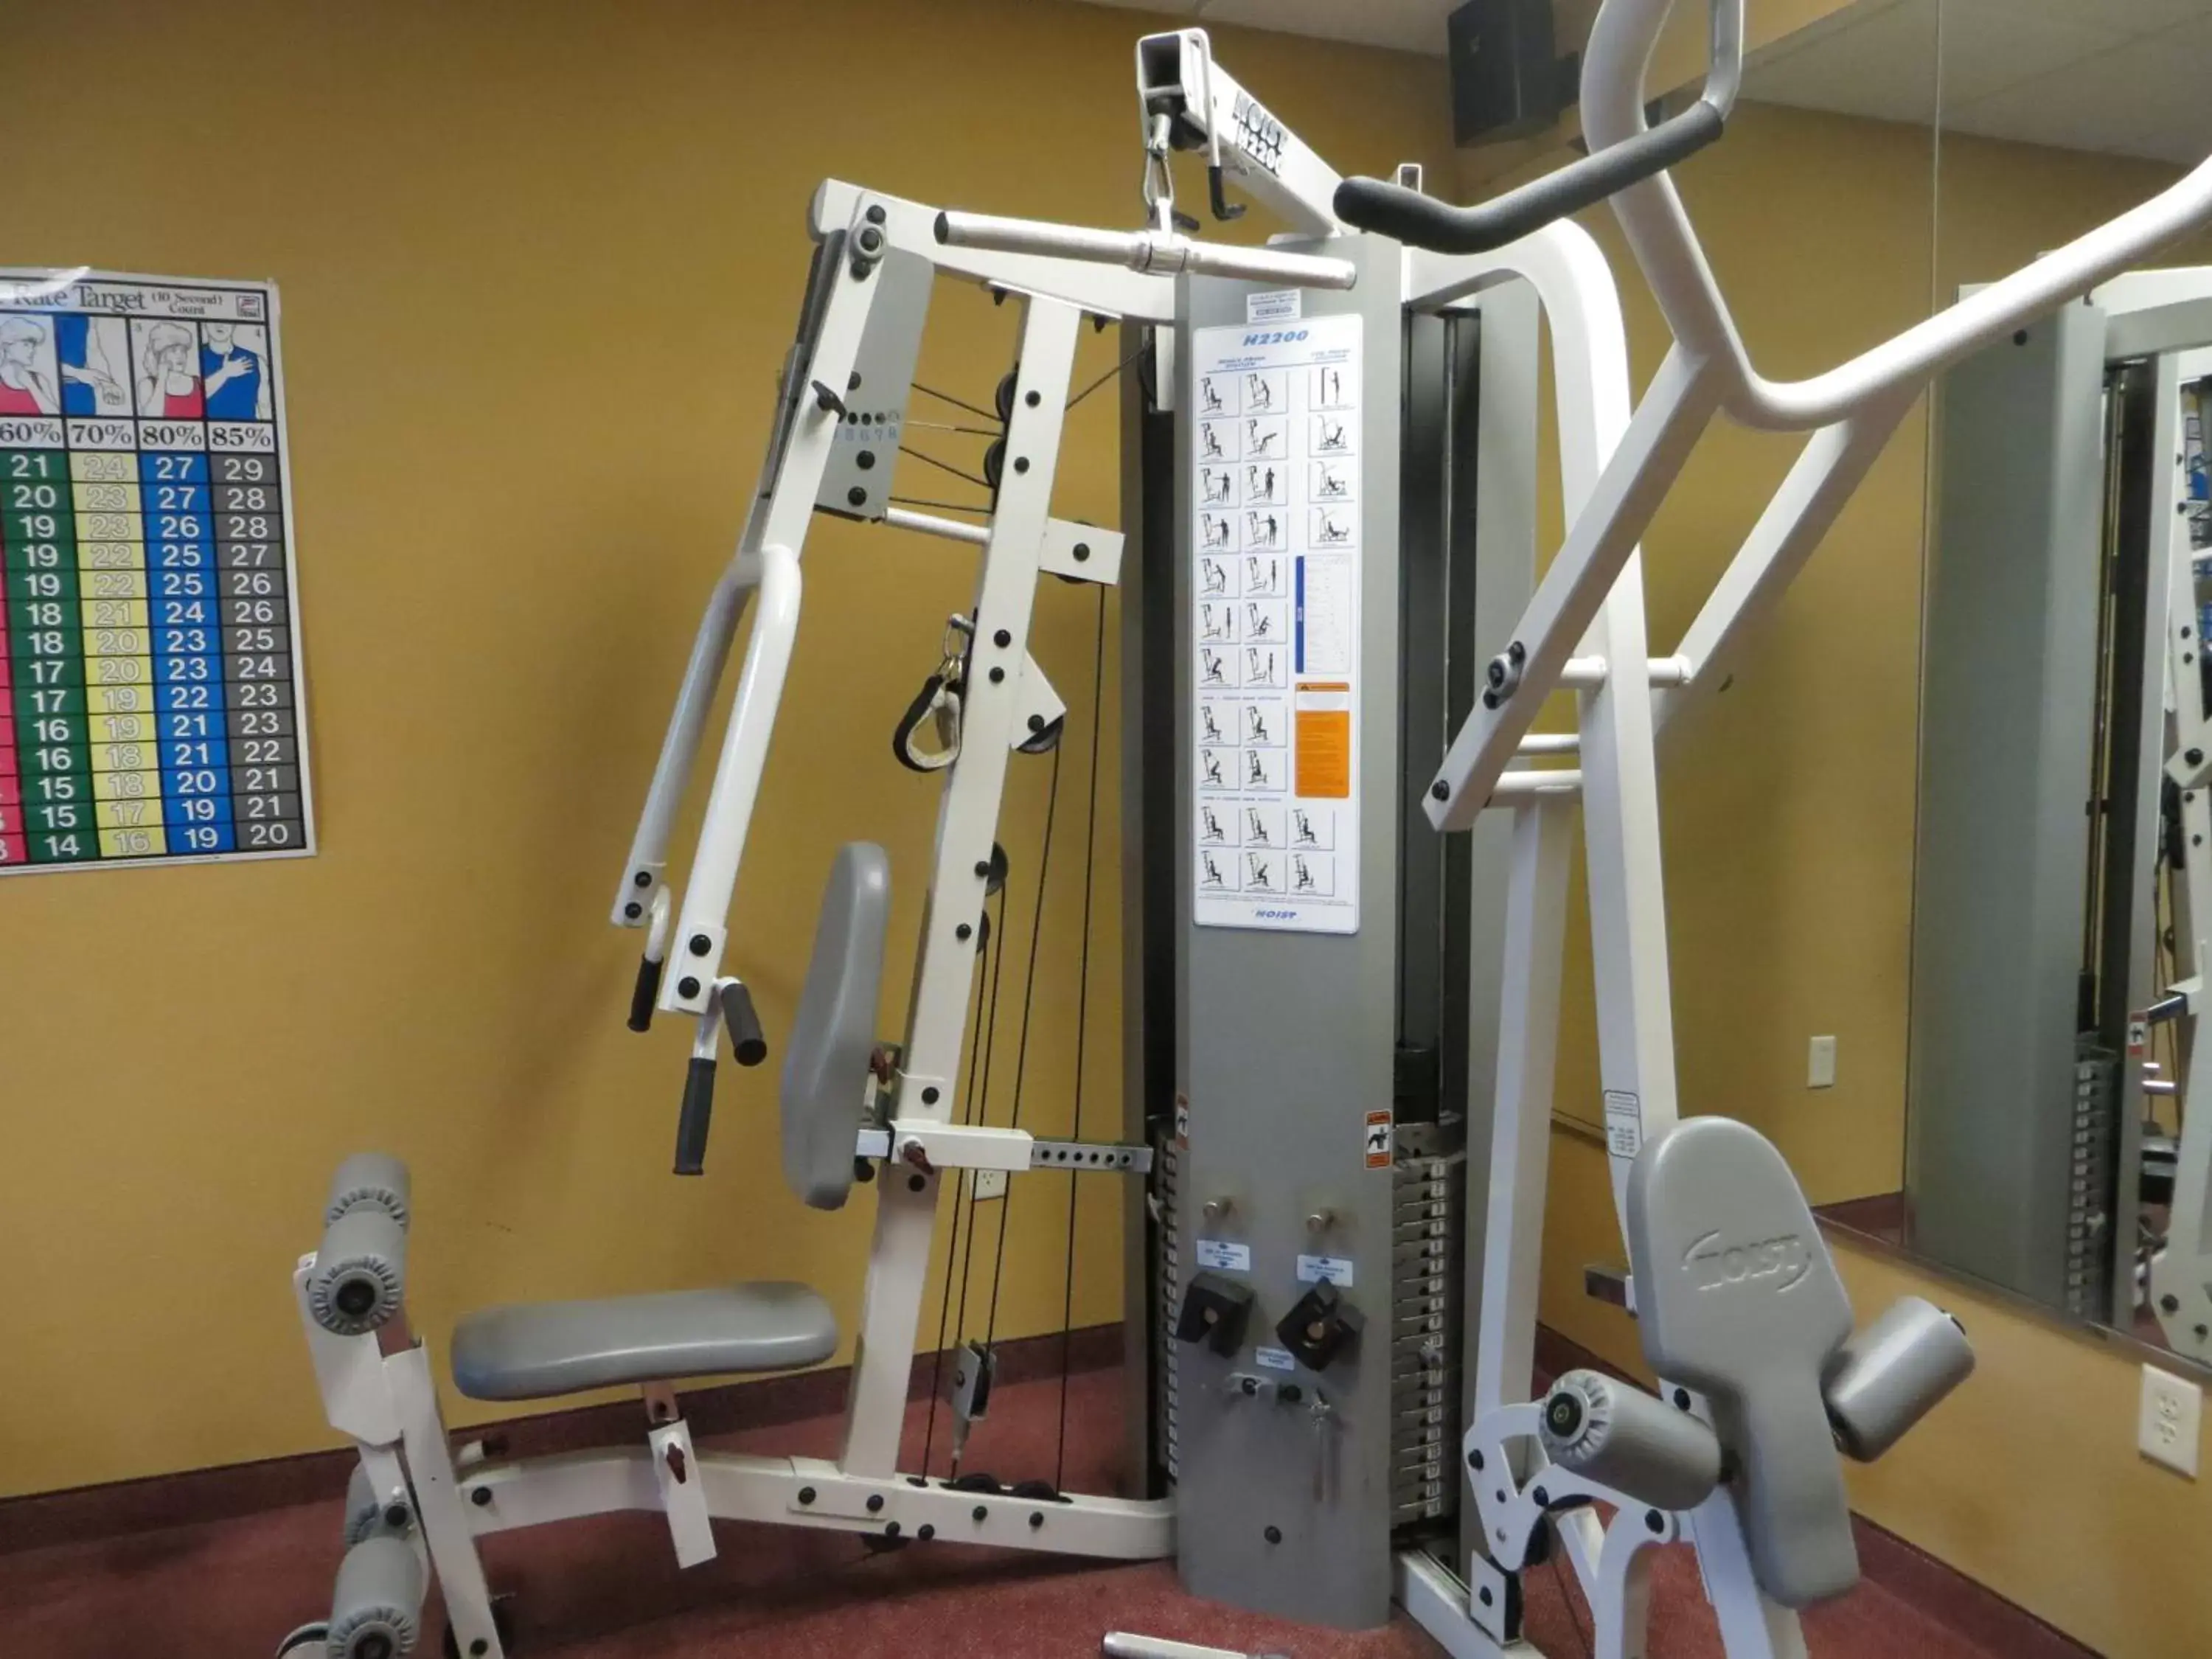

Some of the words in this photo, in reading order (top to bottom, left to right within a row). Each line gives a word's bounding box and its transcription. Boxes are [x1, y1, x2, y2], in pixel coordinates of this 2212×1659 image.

[72, 285, 147, 314] Target
[169, 303, 205, 315] Count
[1242, 330, 1309, 346] H2200
[0, 422, 61, 442] 60%
[72, 424, 132, 444] 70%
[142, 426, 202, 445] 80%
[212, 427, 271, 447] 85%
[11, 454, 48, 477] 21
[86, 456, 126, 480] 24
[156, 456, 193, 479] 27
[224, 458, 263, 481] 29
[13, 484, 57, 509] 20
[88, 486, 128, 510] 23
[158, 486, 195, 509] 27
[227, 487, 266, 510] 28
[19, 515, 55, 538] 19
[90, 515, 131, 539] 23
[160, 515, 200, 538] 26
[229, 515, 268, 539] 28
[23, 543, 59, 568] 19
[92, 543, 133, 568] 22
[162, 543, 201, 567] 25
[231, 544, 268, 566] 27
[24, 573, 60, 597] 19
[94, 573, 135, 597] 22
[163, 572, 204, 596] 25
[233, 572, 271, 595] 26
[26, 602, 63, 626] 18
[97, 602, 131, 626] 21
[165, 601, 205, 624] 24
[234, 600, 274, 623] 26
[28, 630, 64, 654] 18
[97, 630, 138, 654] 20
[167, 629, 206, 653] 23
[236, 628, 274, 650] 25
[29, 661, 64, 684] 17
[100, 659, 141, 684] 20
[168, 657, 208, 681] 23
[238, 655, 276, 678] 24
[31, 689, 66, 713] 17
[102, 687, 139, 712] 19
[170, 685, 209, 709] 22
[240, 684, 278, 706] 23
[33, 718, 69, 742] 16
[106, 715, 142, 740] 19
[173, 714, 206, 737] 21
[240, 712, 279, 734] 23
[35, 747, 72, 771] 16
[107, 744, 142, 768] 18
[175, 742, 209, 765] 21
[243, 740, 281, 762] 22
[38, 776, 74, 799] 15
[109, 772, 145, 796] 18
[177, 770, 216, 793] 20
[246, 768, 278, 790] 21
[41, 804, 77, 828] 15
[111, 800, 145, 824] 17
[181, 799, 215, 821] 19
[247, 796, 280, 818] 21
[45, 834, 80, 857] 14
[114, 830, 150, 855] 16
[184, 827, 218, 849] 19
[250, 824, 288, 845] 20
[1255, 911, 1297, 919] HOIST
